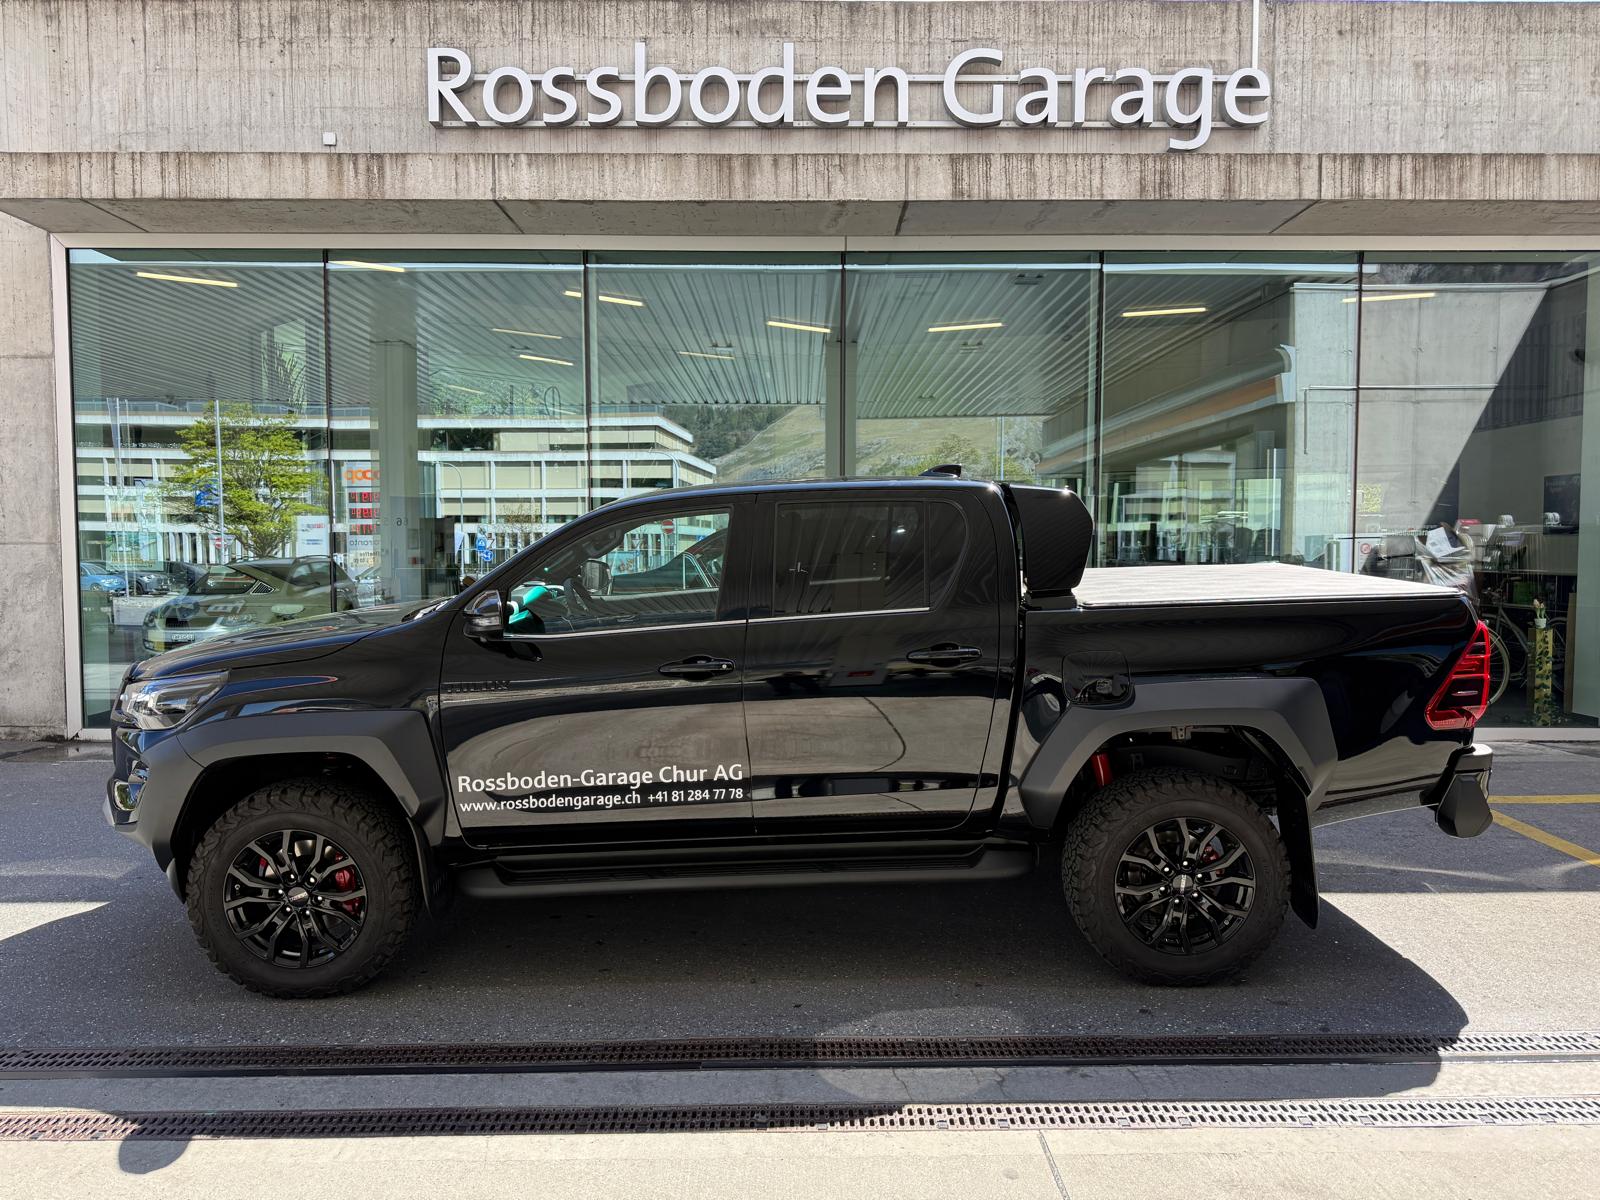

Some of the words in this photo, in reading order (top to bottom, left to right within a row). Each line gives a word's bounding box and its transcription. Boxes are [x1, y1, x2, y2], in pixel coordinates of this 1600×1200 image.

[427, 42, 910, 128] Rossboden
[943, 47, 1271, 151] Garage
[457, 770, 653, 793] Rossboden-Garage
[658, 766, 708, 784] Chur
[713, 763, 744, 782] AG
[459, 793, 642, 812] www.rossbodengarage.ch
[647, 791, 669, 803] +41
[671, 790, 685, 802] 81
[687, 789, 710, 802] 284
[712, 788, 727, 800] 77
[729, 788, 744, 800] 78
